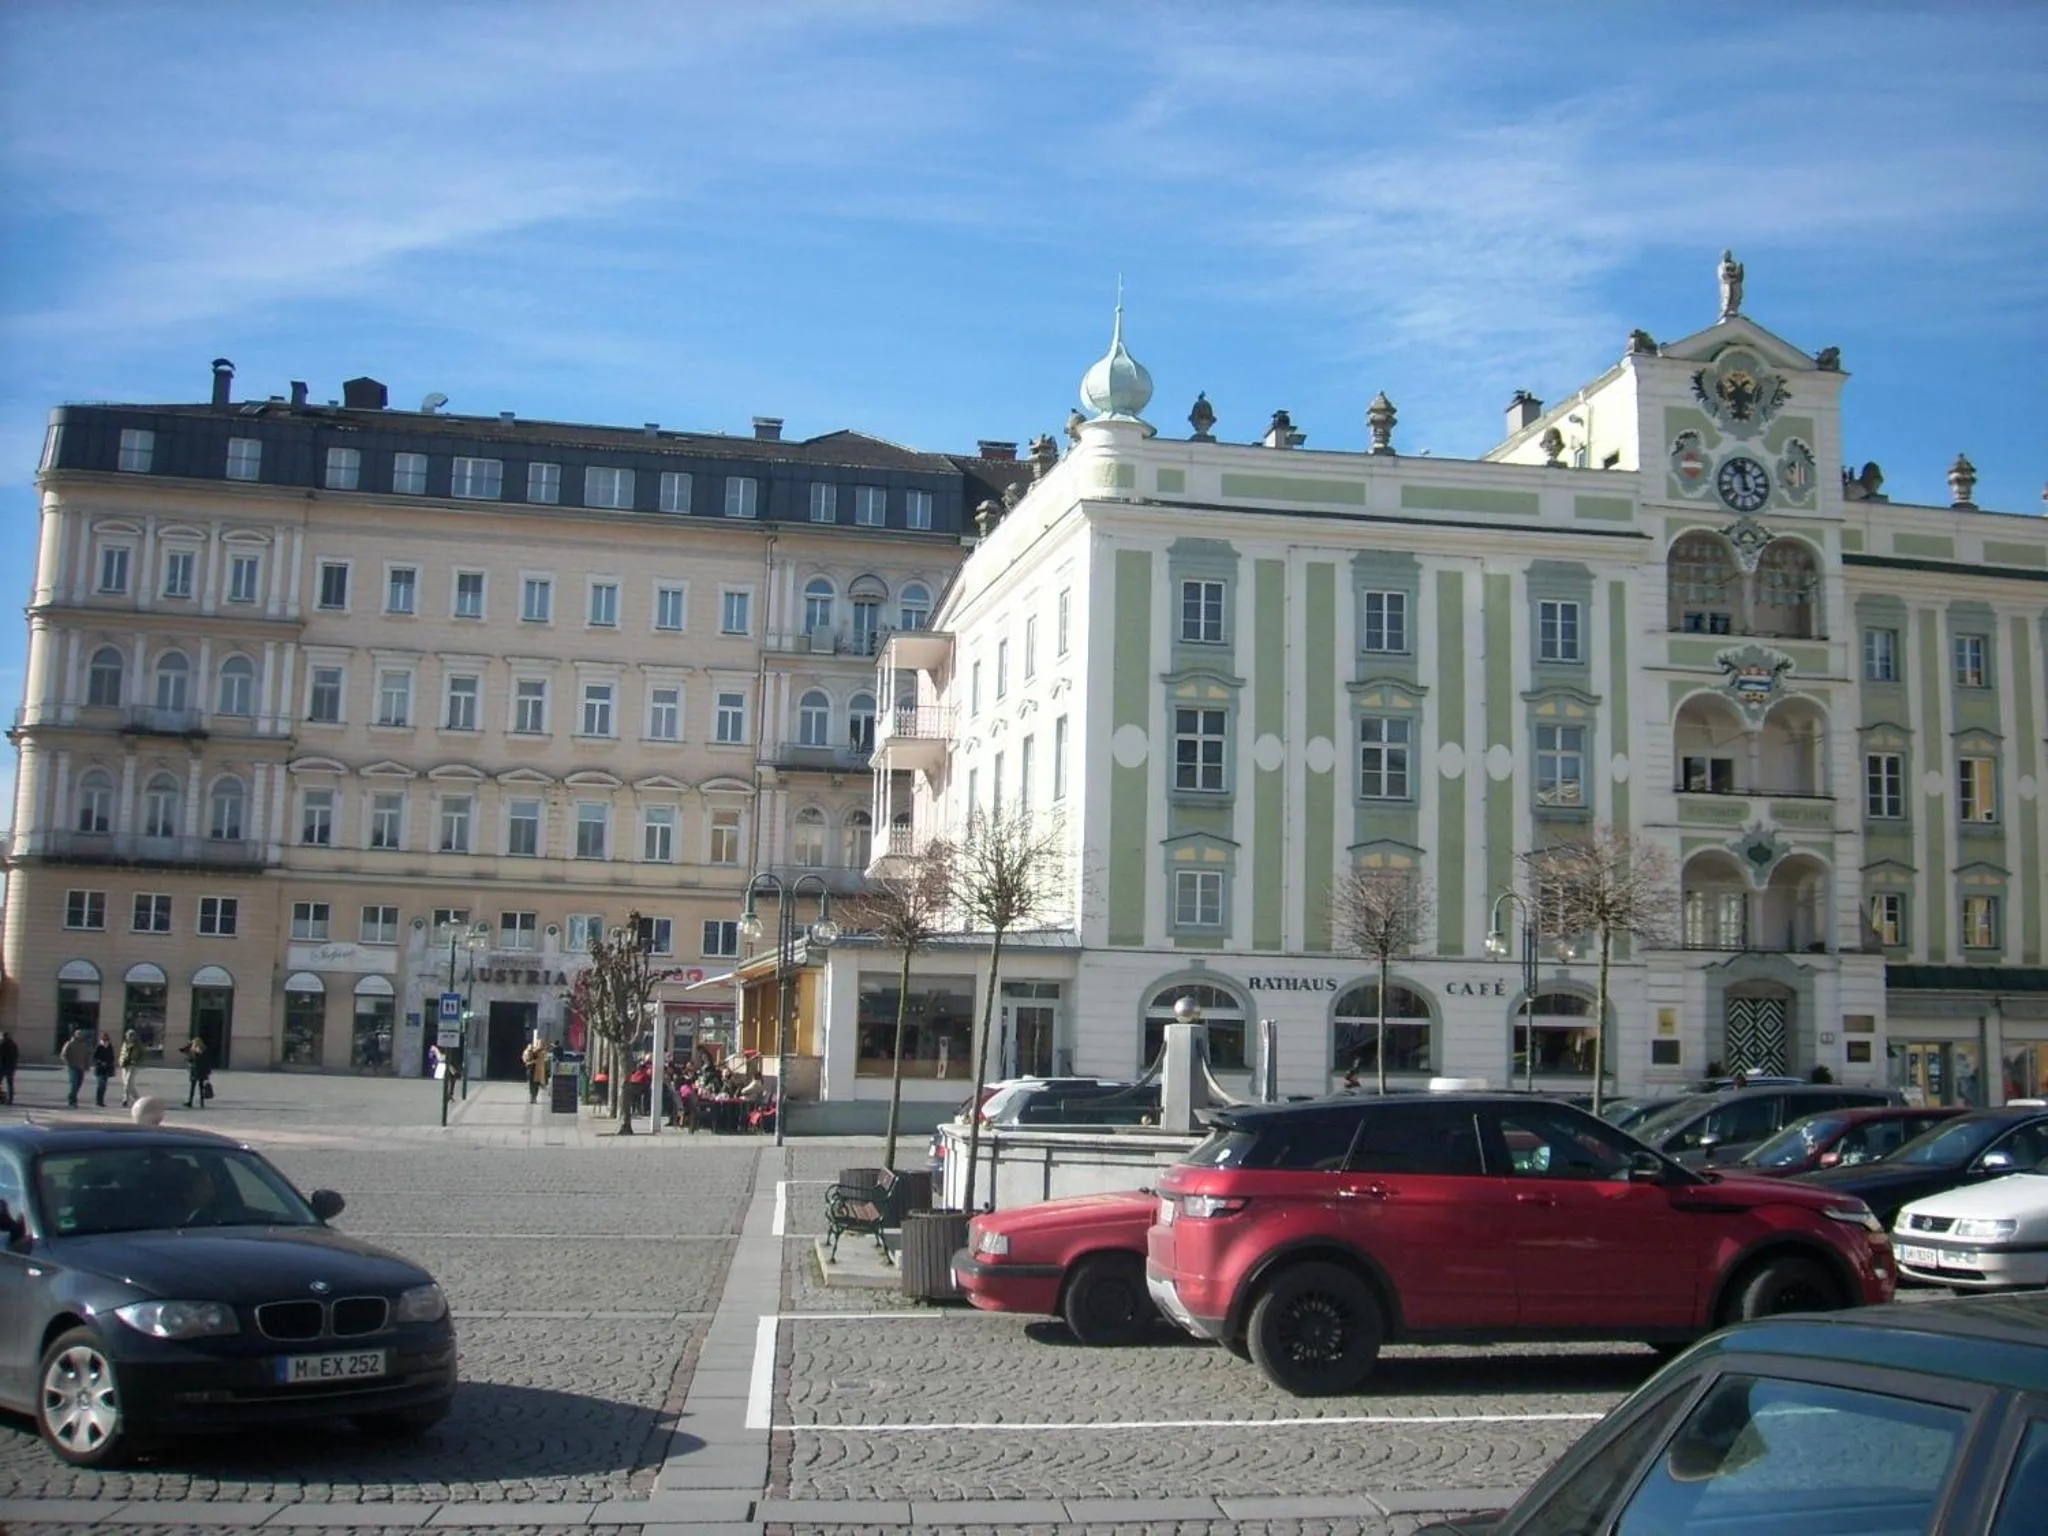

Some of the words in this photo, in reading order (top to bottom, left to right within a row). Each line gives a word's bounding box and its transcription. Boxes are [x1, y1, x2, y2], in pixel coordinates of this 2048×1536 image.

[461, 967, 569, 986] AUSTRIA
[1248, 976, 1339, 992] RATHAUS
[1445, 977, 1507, 996] CAFÉ
[295, 1359, 308, 1378] M
[320, 1357, 344, 1377] EX
[348, 1354, 380, 1375] 252
